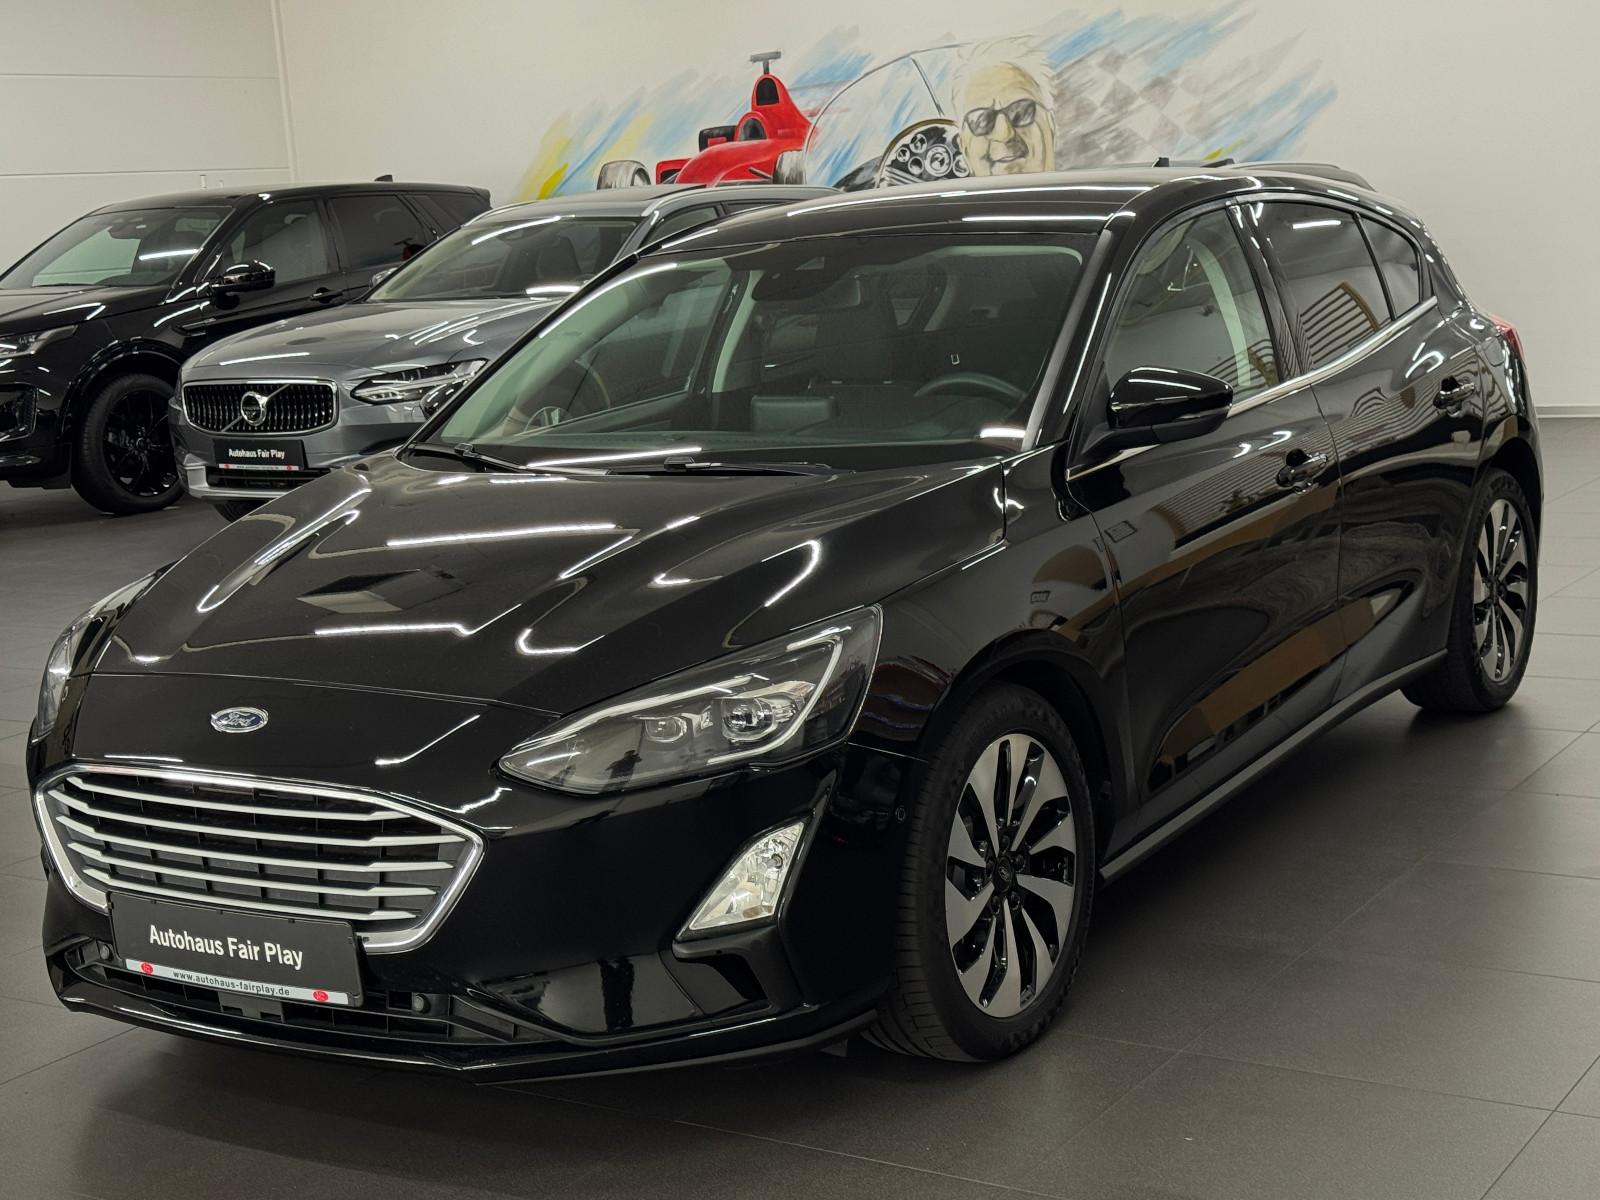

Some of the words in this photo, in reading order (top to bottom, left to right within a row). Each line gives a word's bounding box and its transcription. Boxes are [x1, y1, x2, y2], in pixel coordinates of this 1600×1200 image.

[228, 448, 257, 458] Autohaus
[257, 449, 270, 458] Fair
[270, 449, 285, 460] Play
[149, 924, 224, 957] Autohaus
[227, 937, 260, 961] Fair
[265, 942, 303, 971] Play
[173, 970, 290, 997] www.autohaus-fairplay.de
